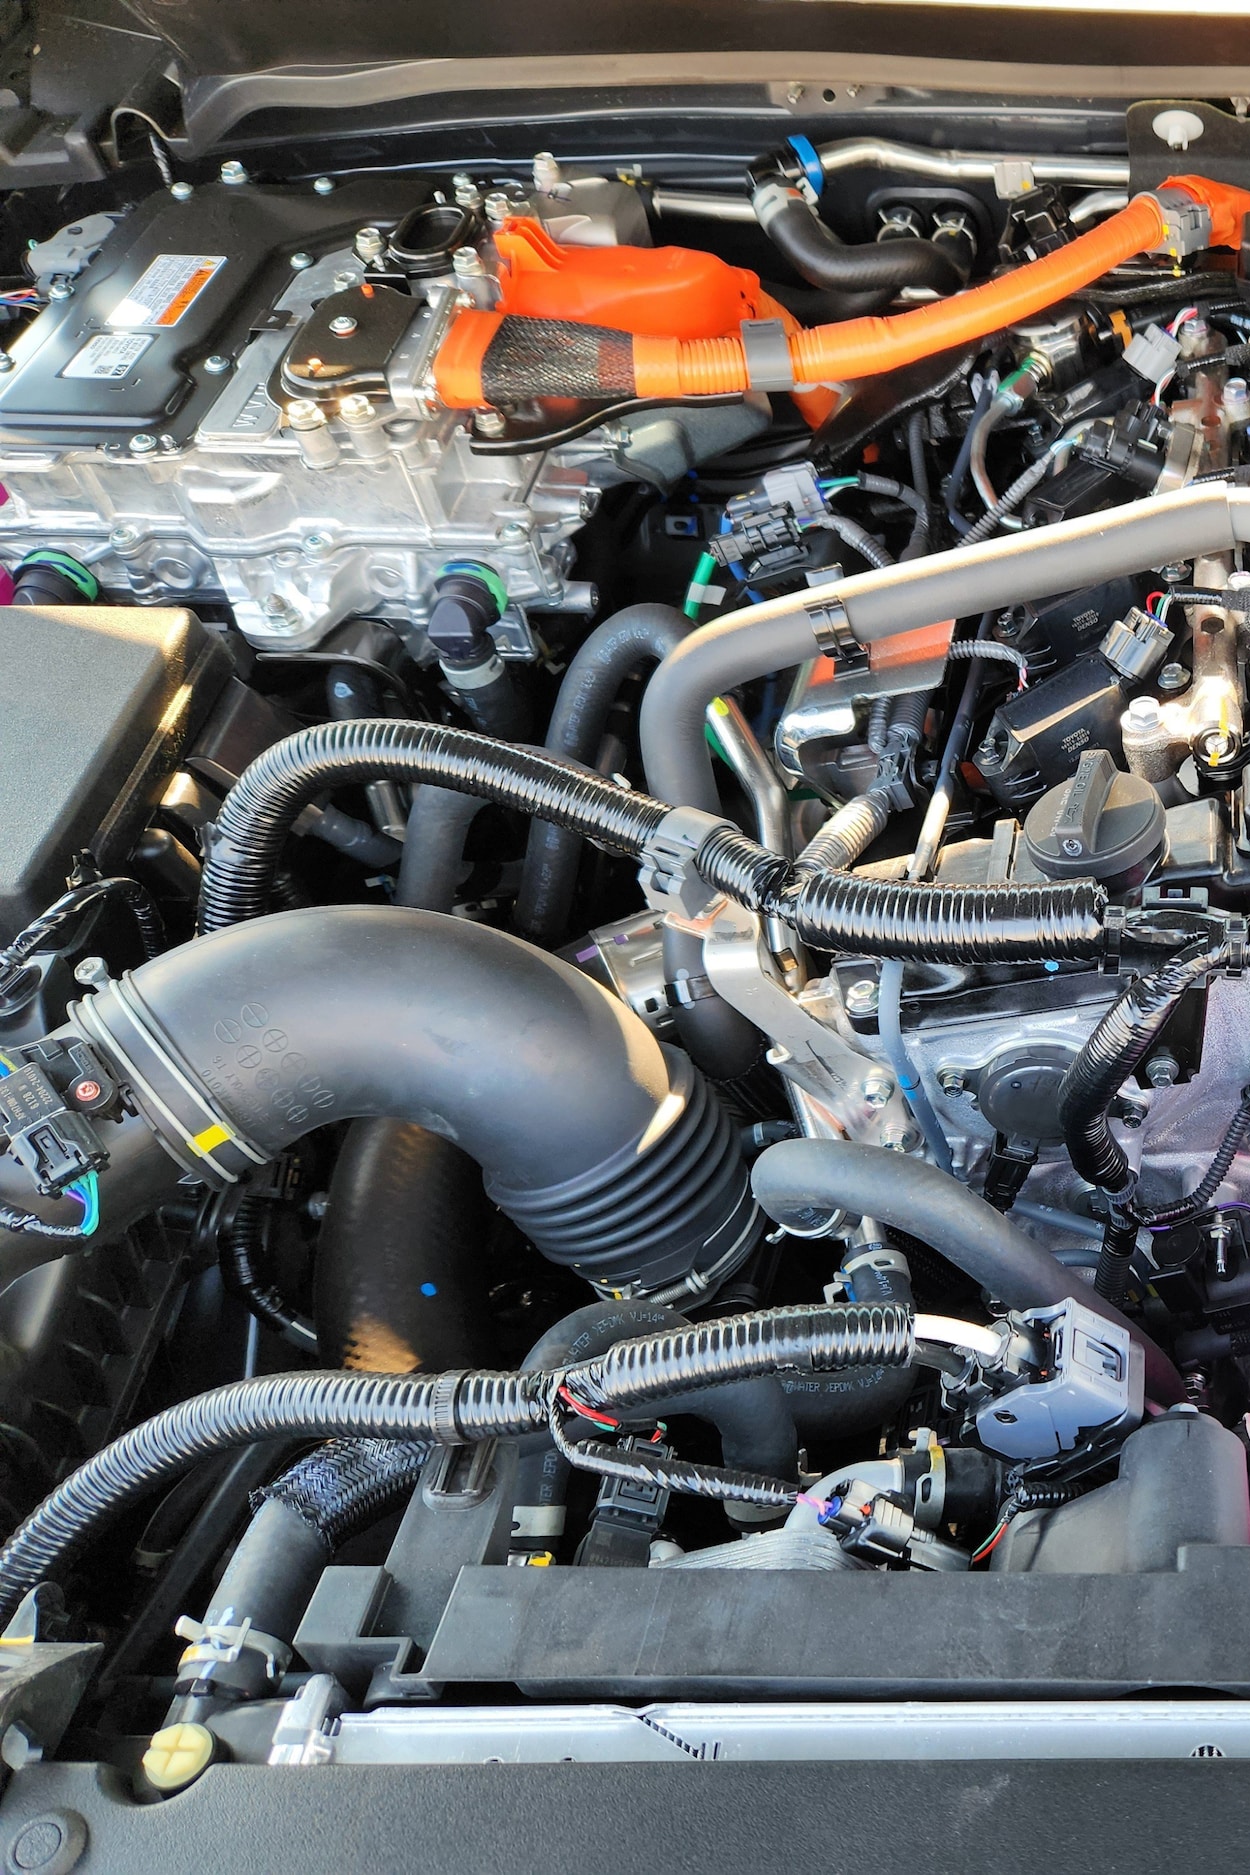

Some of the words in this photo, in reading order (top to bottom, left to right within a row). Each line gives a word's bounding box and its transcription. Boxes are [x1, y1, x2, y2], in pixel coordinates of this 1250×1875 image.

[1072, 609, 1096, 624] TOYOTA
[1077, 617, 1099, 632] DENSO
[1062, 727, 1086, 744] TOYOTA
[1067, 736, 1090, 753] DENSO
[1072, 782, 1086, 797] OIL
